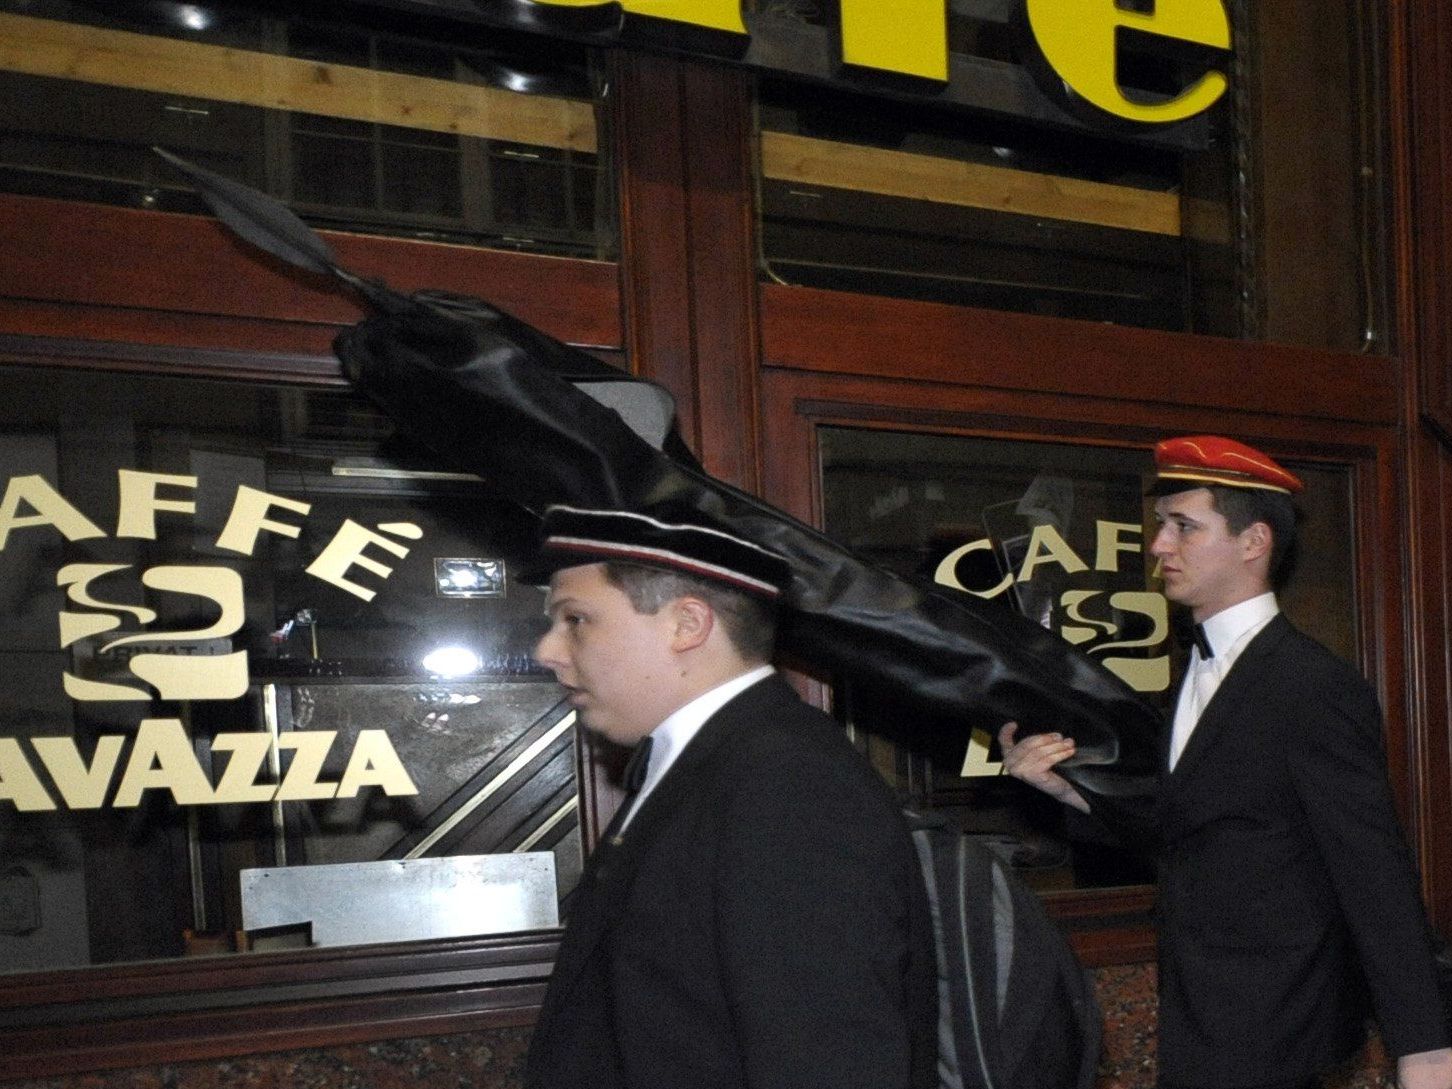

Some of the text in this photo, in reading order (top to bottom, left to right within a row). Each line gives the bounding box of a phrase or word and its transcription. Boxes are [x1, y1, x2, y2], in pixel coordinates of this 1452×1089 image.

[0, 469, 423, 602] AFFÉ
[934, 520, 1162, 600] CAF
[0, 719, 419, 811] AVAZZA
